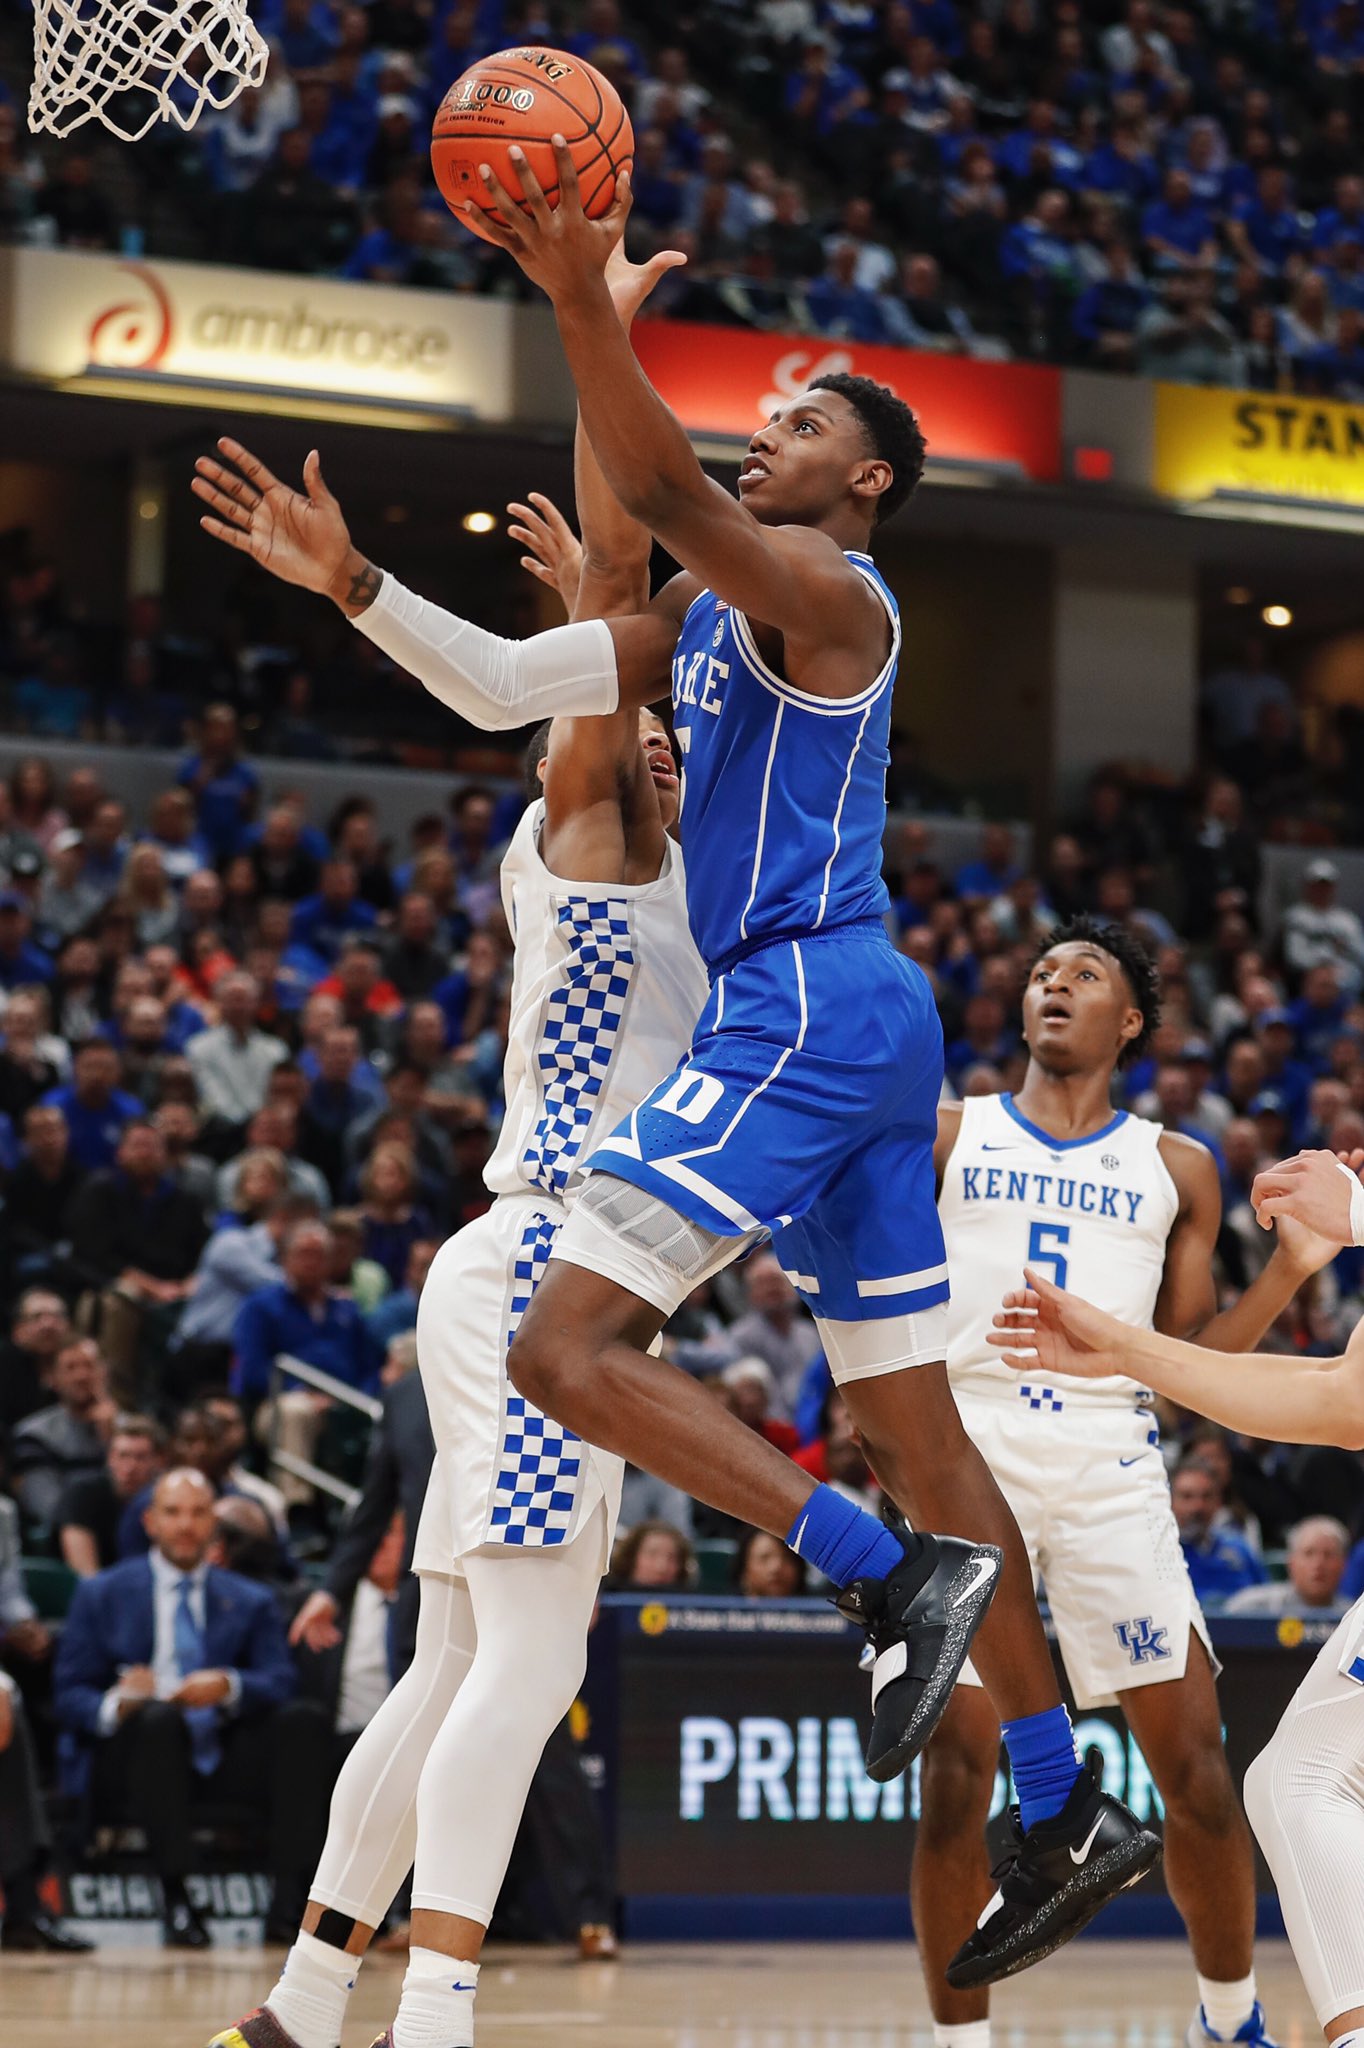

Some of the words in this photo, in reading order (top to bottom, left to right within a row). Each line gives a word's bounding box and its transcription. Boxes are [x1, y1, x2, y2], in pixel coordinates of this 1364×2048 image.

[449, 80, 534, 111] 1000
[477, 115, 505, 126] DESIGN
[193, 301, 451, 375] ambrose
[671, 651, 730, 715] UKE
[651, 1069, 725, 1125] D
[963, 1167, 1143, 1223] KENTUCKY
[1026, 1221, 1070, 1291] 5
[1112, 1616, 1172, 1666] UK
